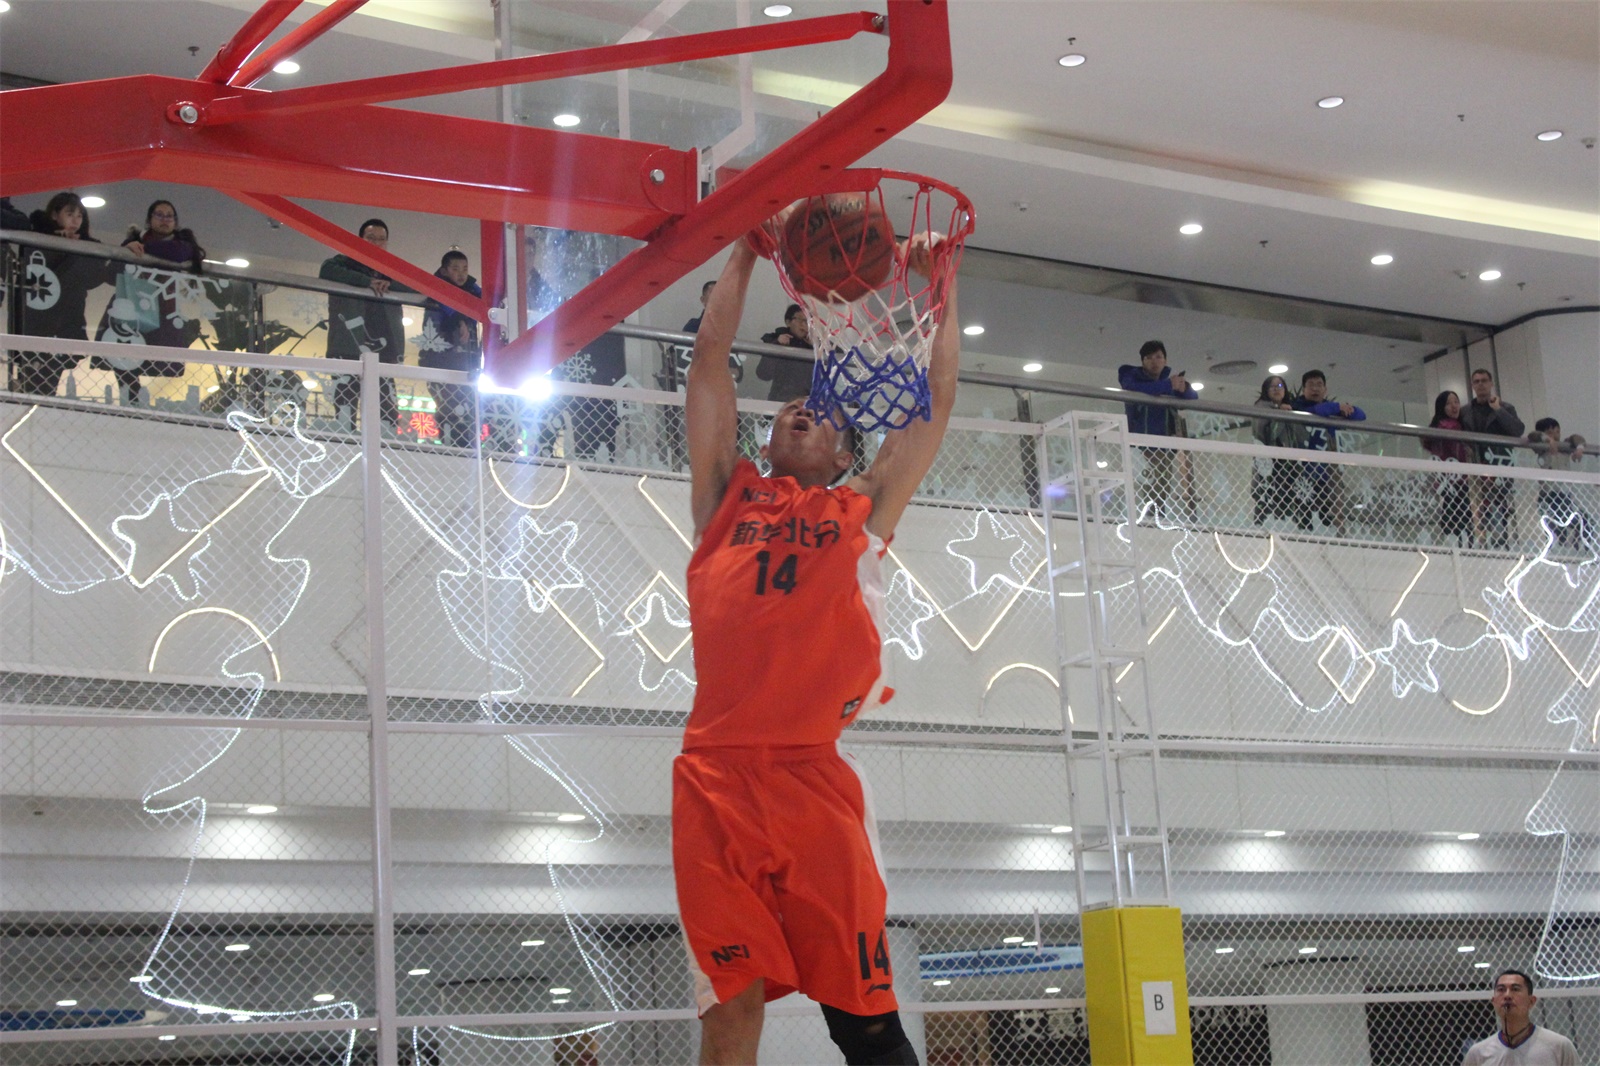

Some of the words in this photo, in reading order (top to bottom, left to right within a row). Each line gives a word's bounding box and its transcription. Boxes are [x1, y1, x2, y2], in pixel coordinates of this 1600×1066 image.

[755, 550, 798, 595] 14
[857, 929, 889, 980] 14
[1154, 993, 1164, 1011] B
